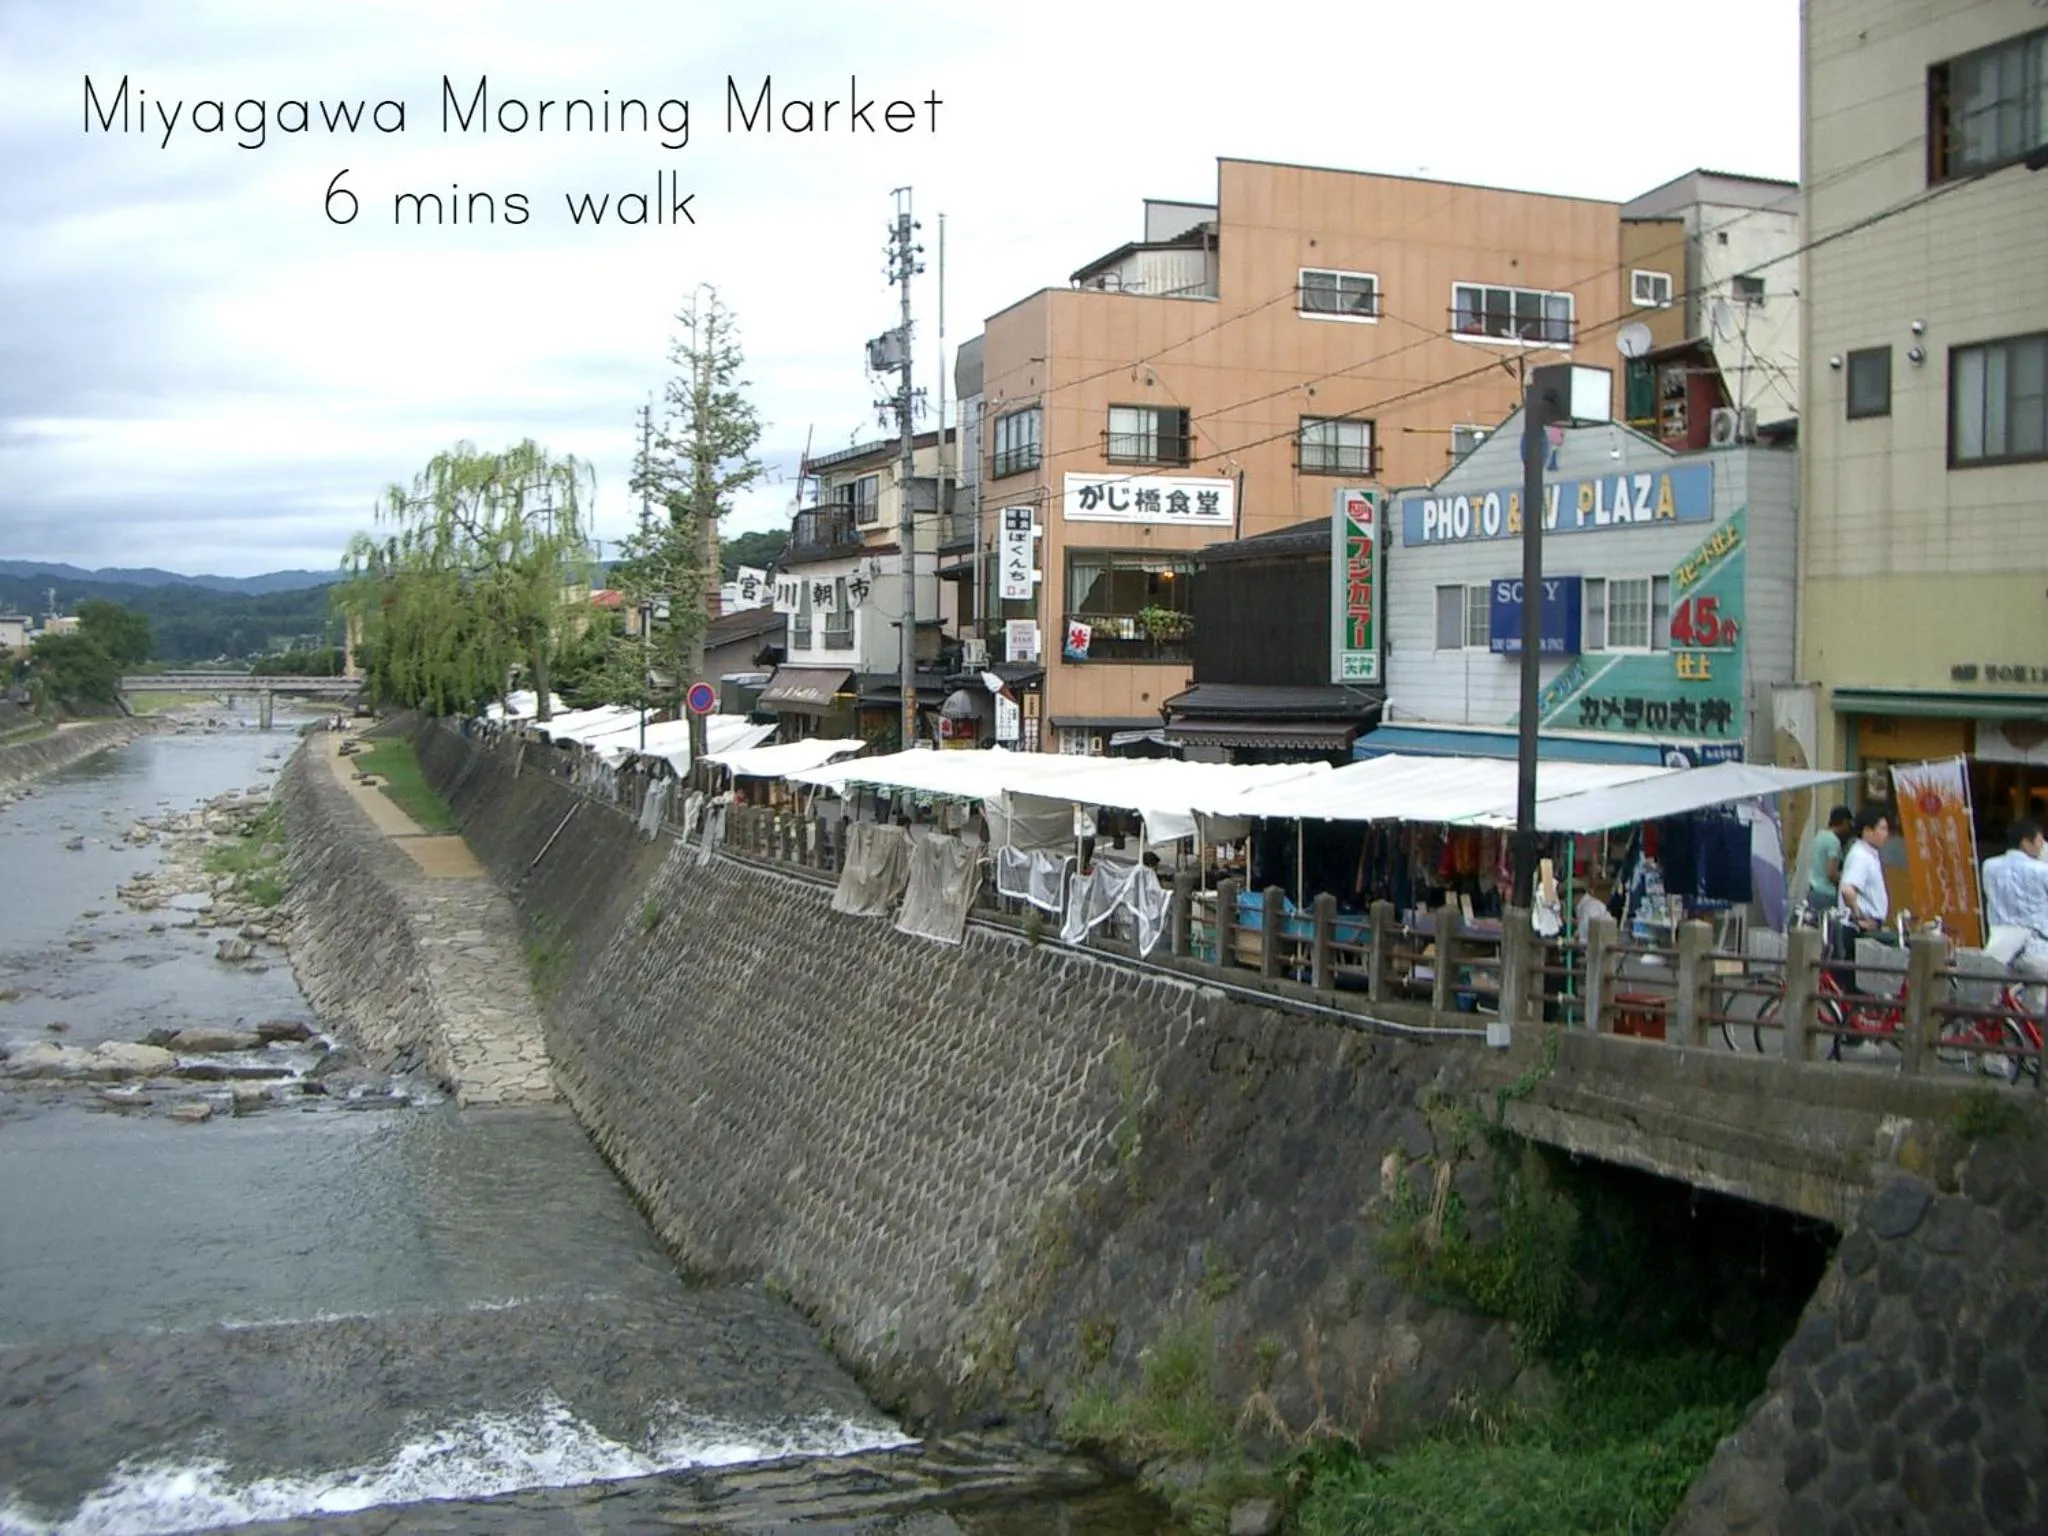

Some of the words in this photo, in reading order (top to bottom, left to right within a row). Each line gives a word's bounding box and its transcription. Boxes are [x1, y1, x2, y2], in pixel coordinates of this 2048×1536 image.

[1423, 491, 1501, 540] PHOTO
[1507, 491, 1525, 533] &
[1576, 473, 1676, 526] PLAZA
[1347, 536, 1372, 648] フジカラー
[1497, 581, 1560, 604] SOY
